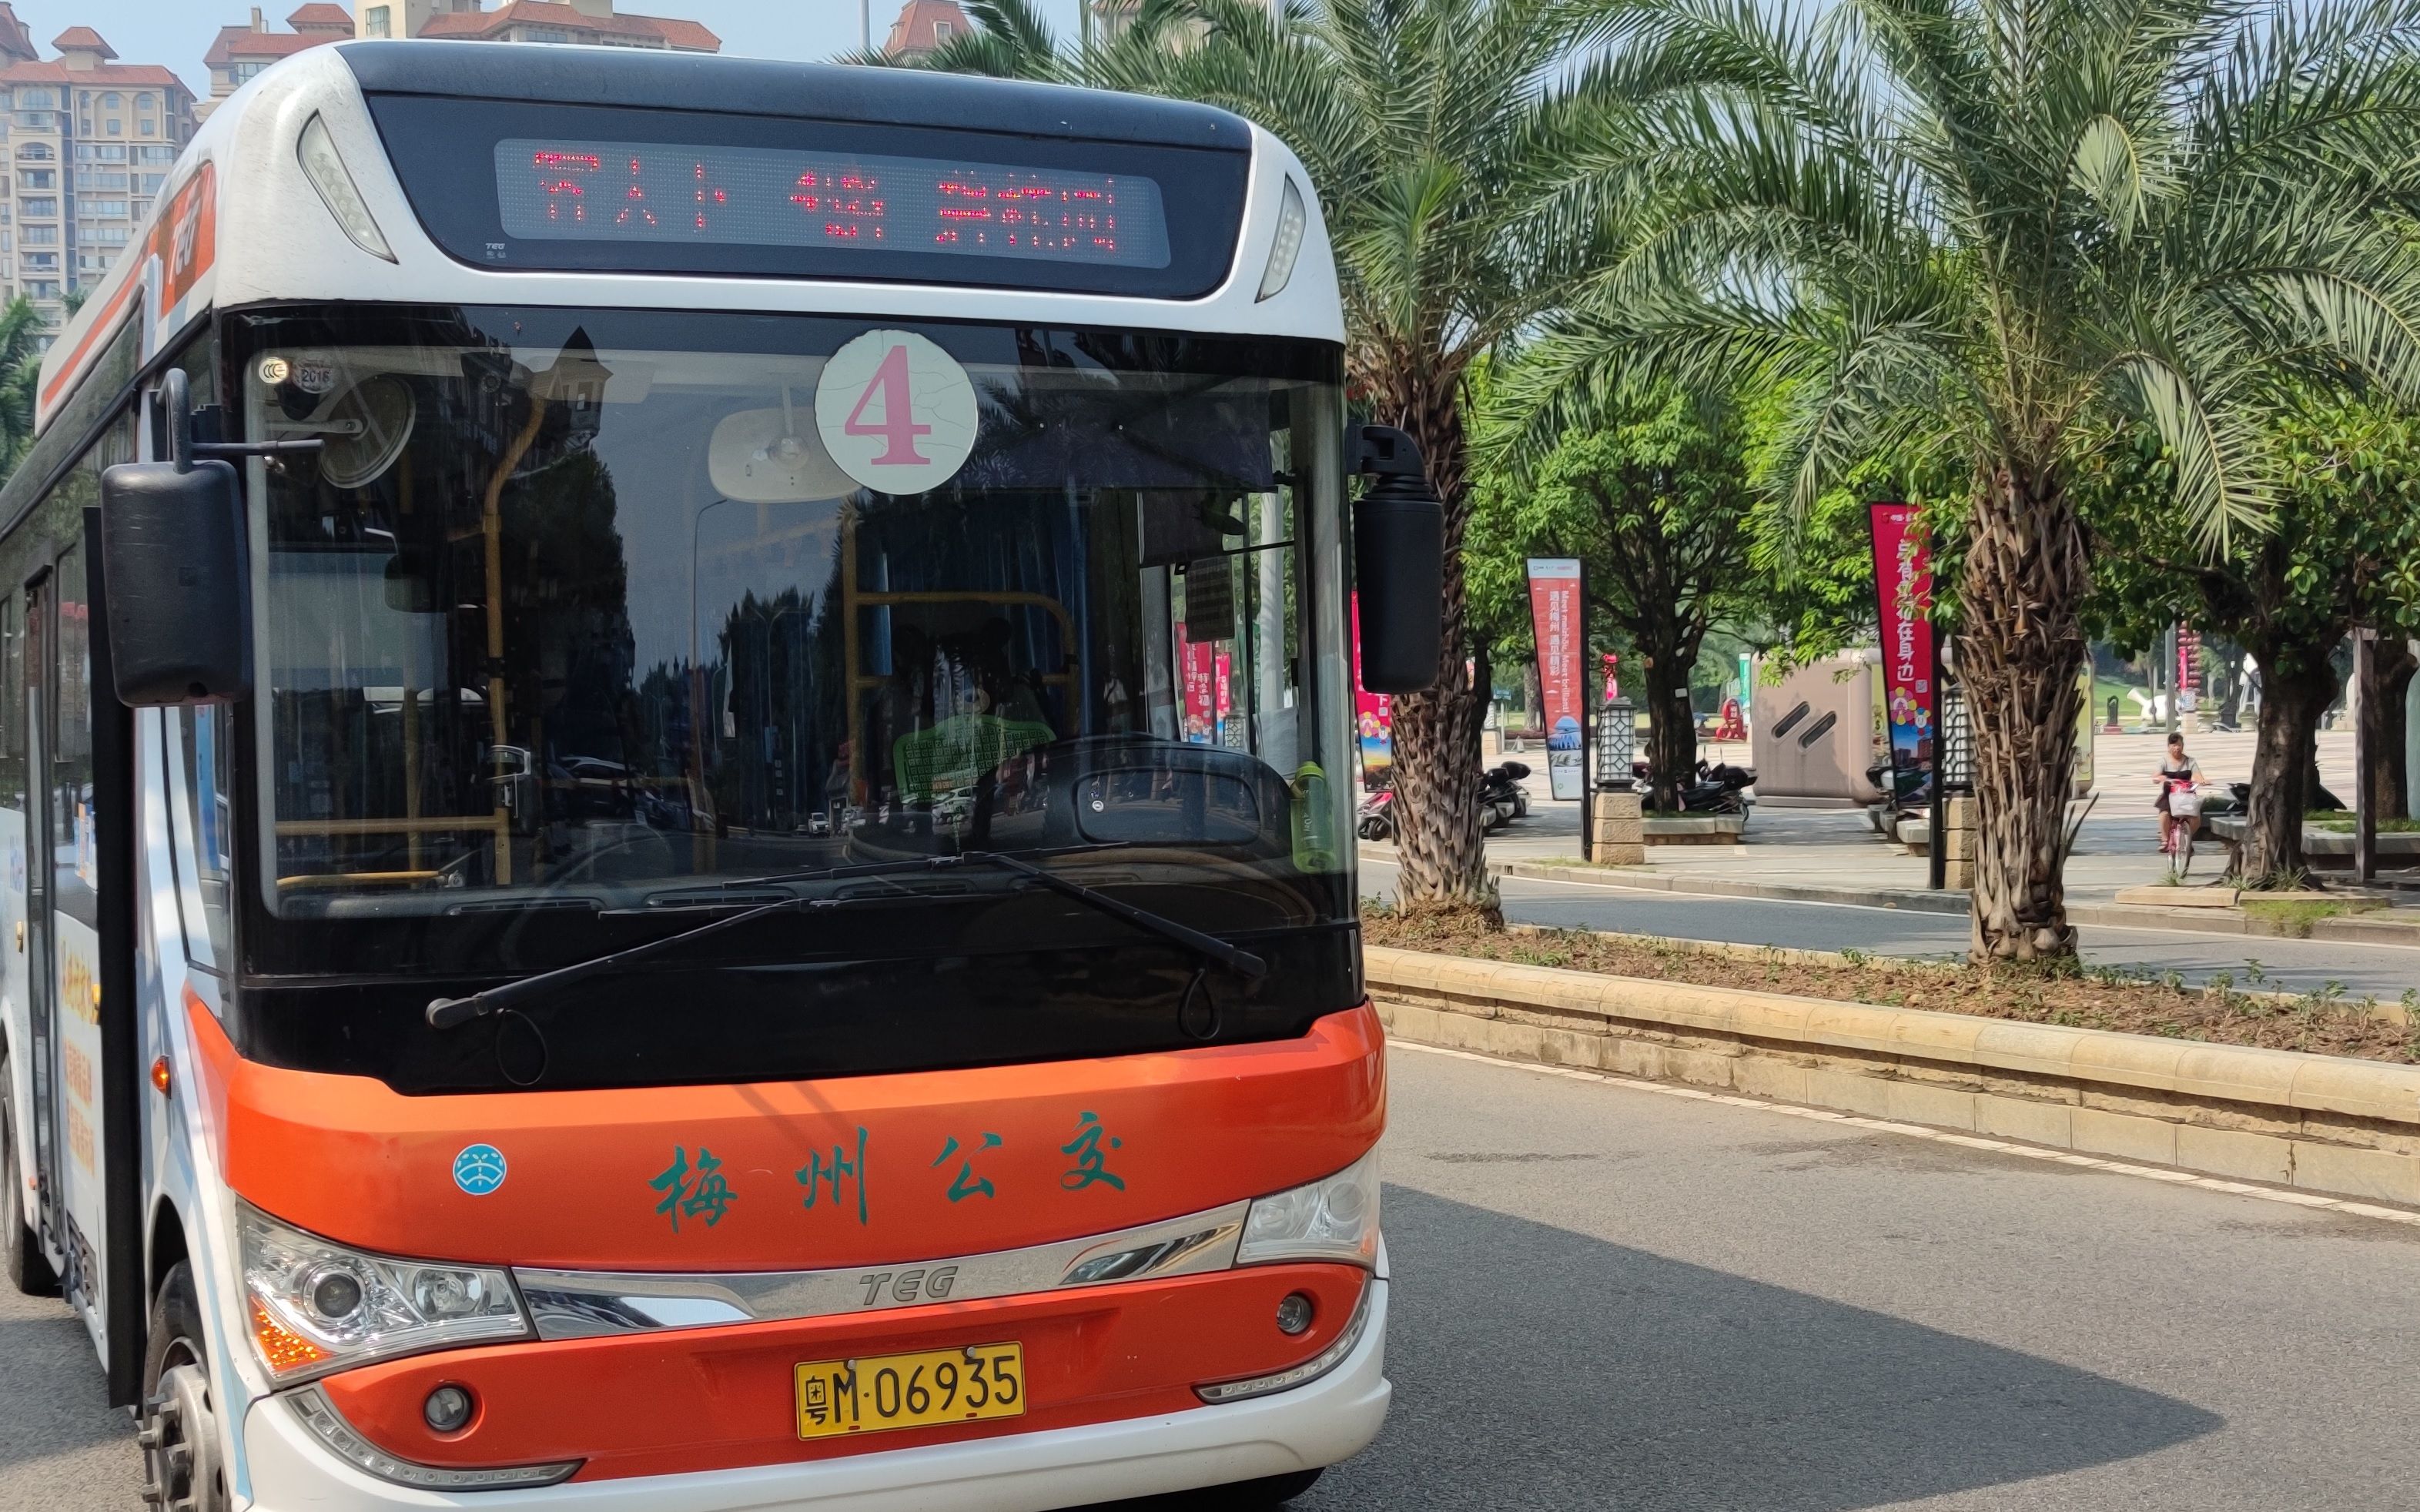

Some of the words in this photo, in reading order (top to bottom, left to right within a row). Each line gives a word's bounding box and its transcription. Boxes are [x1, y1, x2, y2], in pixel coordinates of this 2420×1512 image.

[845, 345, 932, 465] 4
[649, 1112, 1126, 1233] 梅州公交
[859, 1266, 959, 1306] TEG
